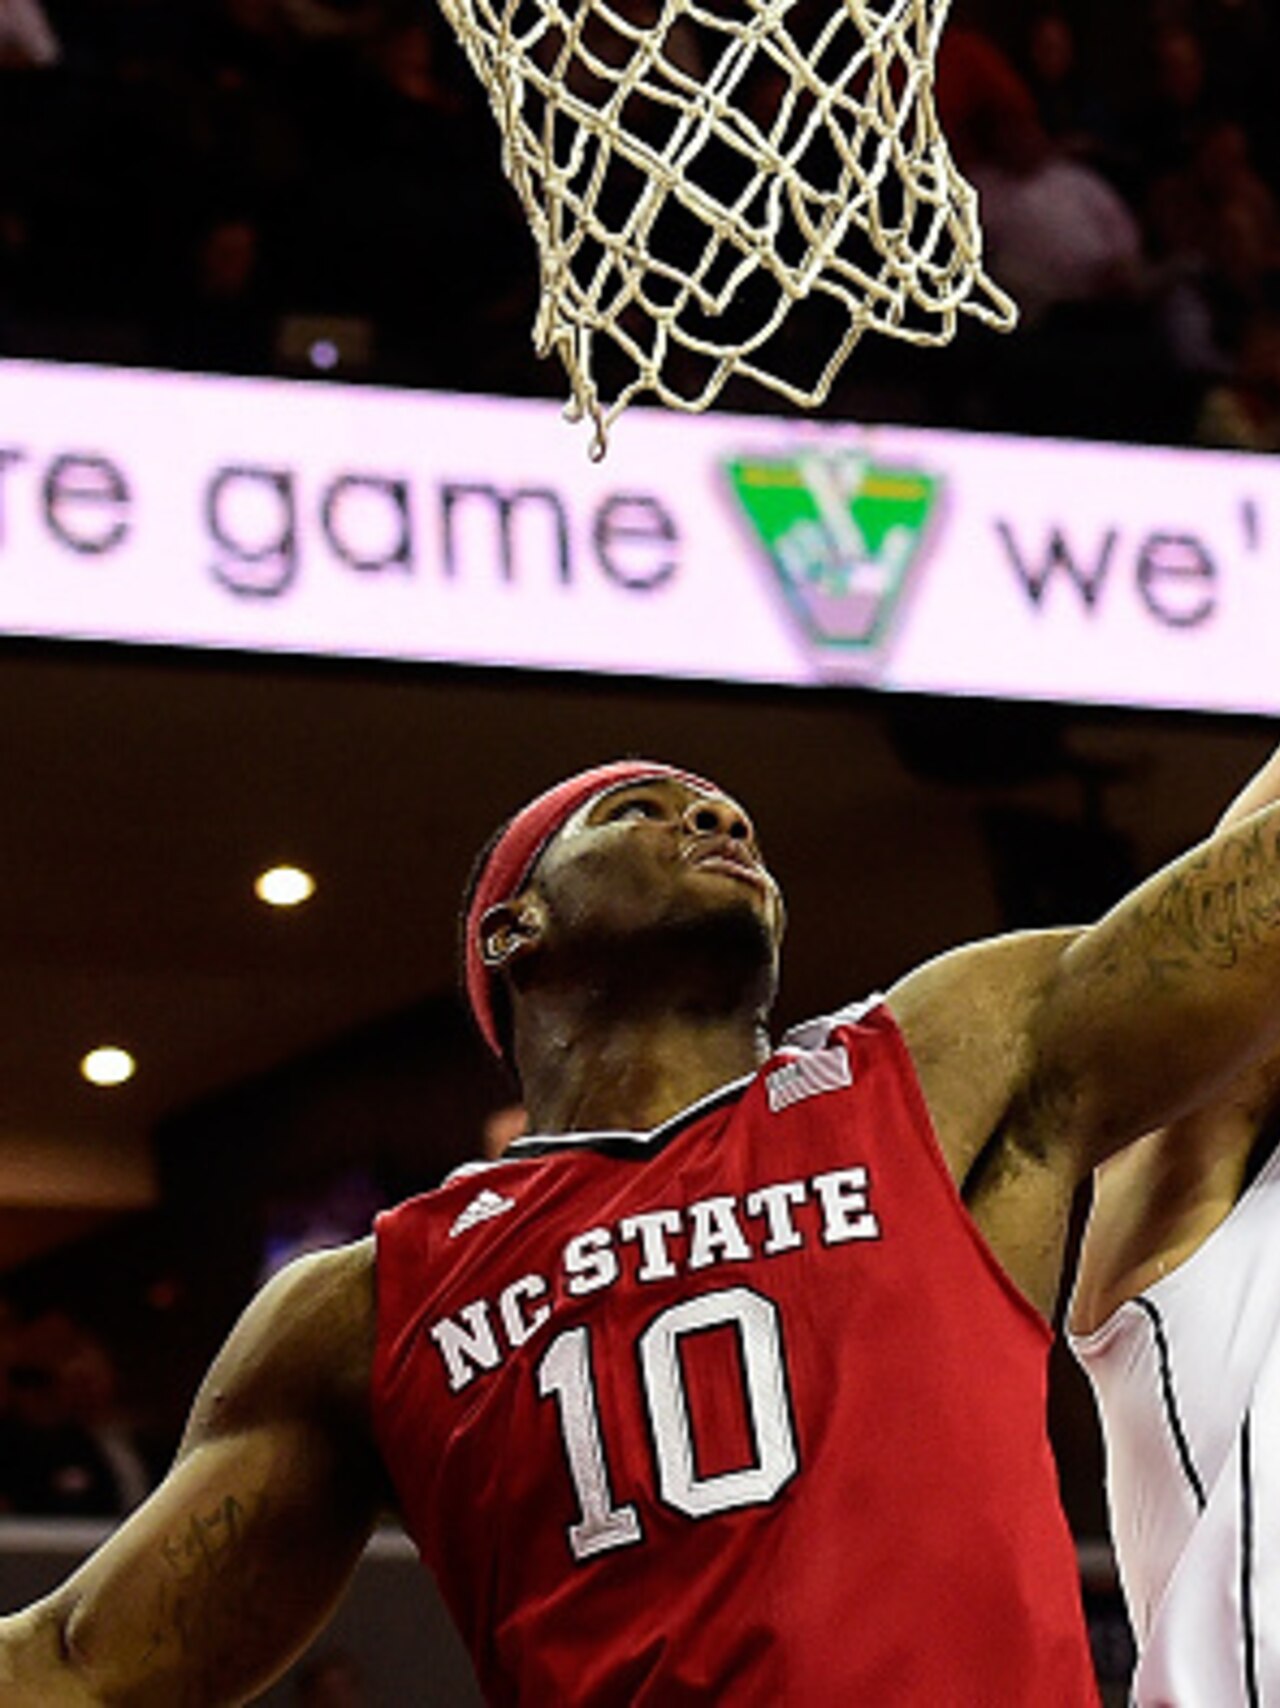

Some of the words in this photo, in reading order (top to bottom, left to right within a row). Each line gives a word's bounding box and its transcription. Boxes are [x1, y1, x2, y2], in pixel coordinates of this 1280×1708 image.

[207, 463, 680, 598] game
[430, 1272, 553, 1392] NC
[560, 1166, 880, 1297] STATE
[536, 1285, 799, 1562] 10
